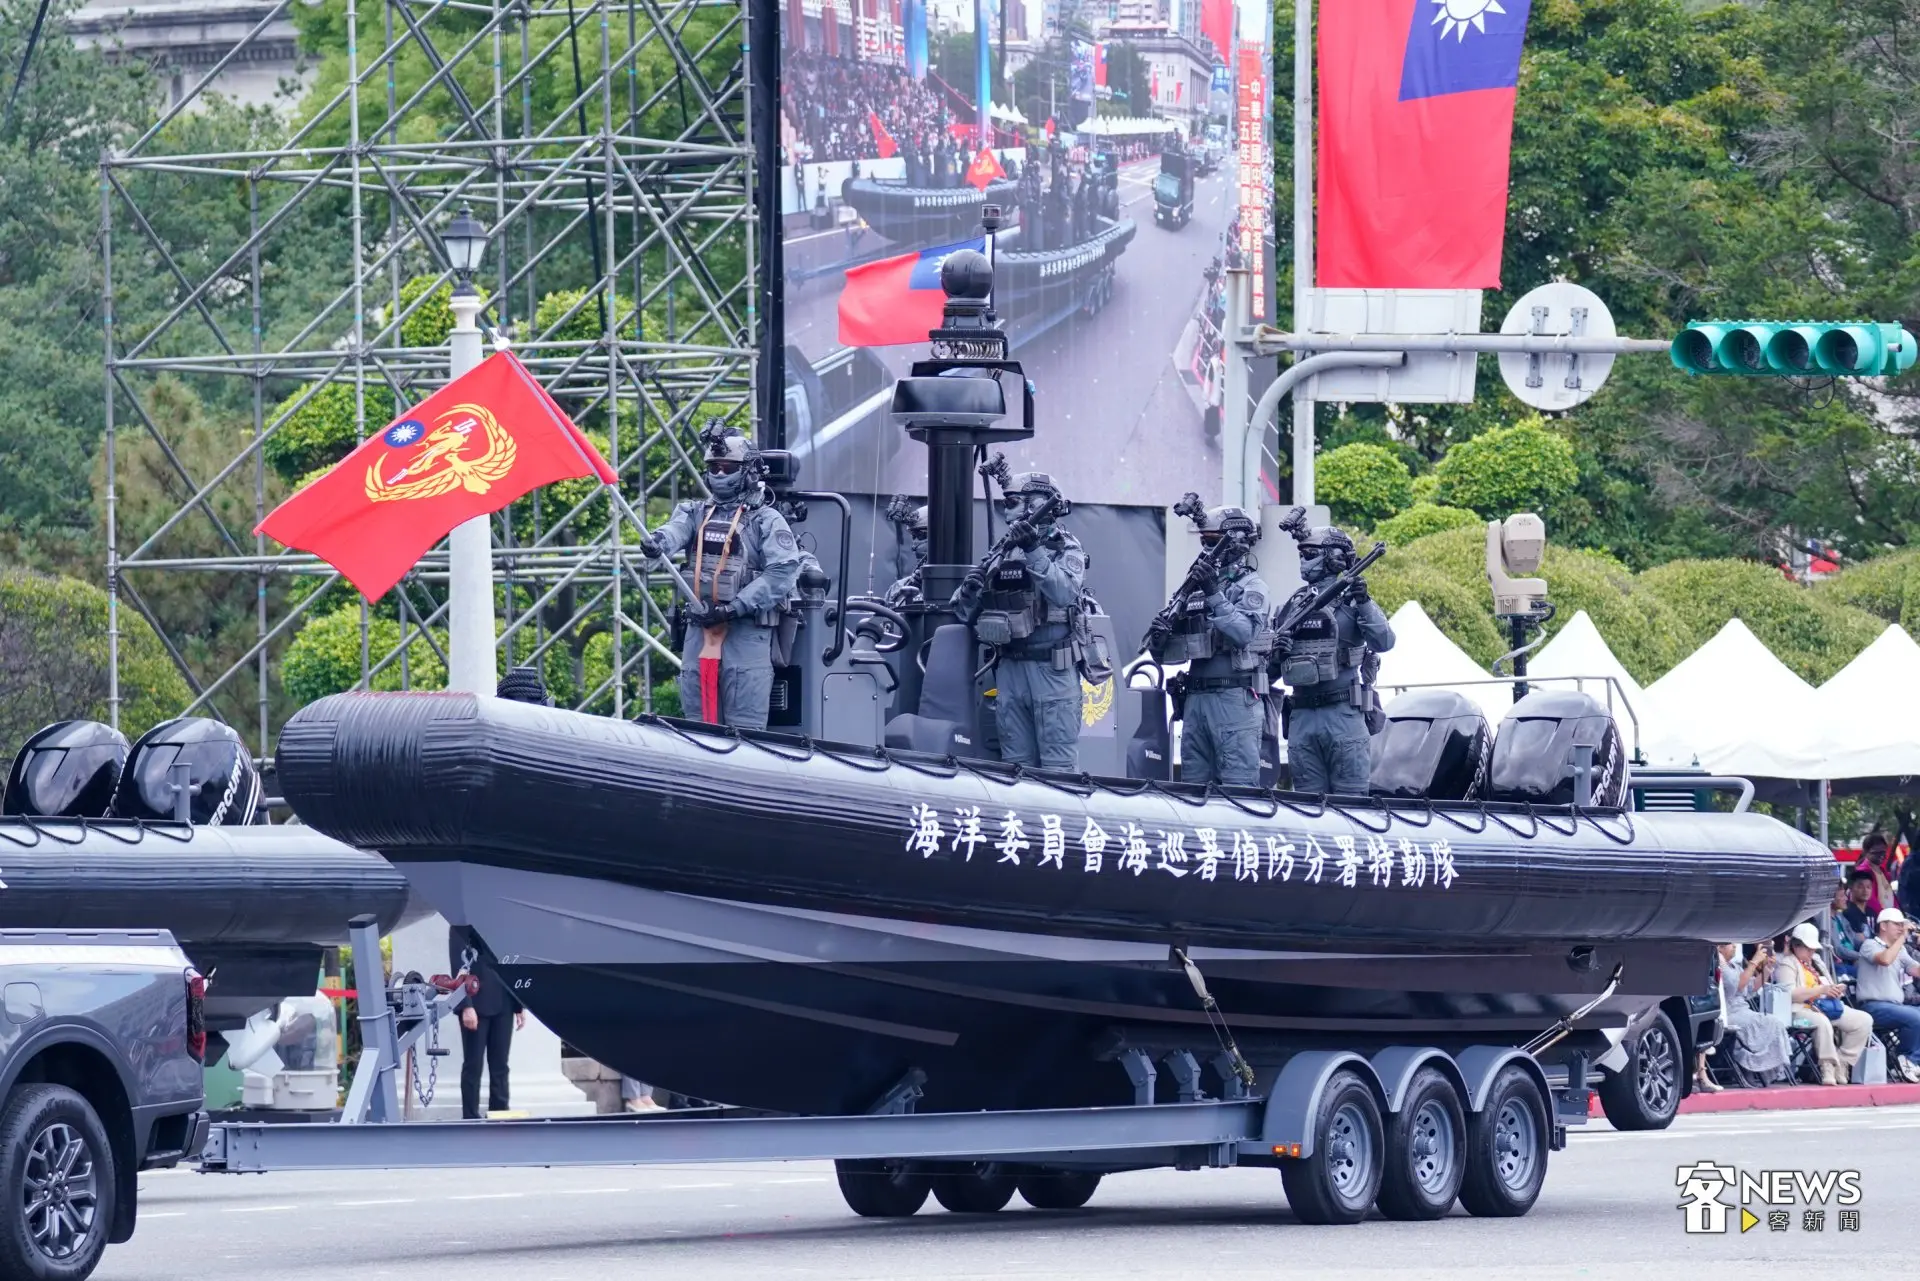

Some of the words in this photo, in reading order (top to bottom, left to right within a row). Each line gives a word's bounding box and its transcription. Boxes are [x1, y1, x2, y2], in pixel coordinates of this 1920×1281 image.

[207, 751, 243, 827] ERCURY
[1590, 728, 1618, 807] ERCURY
[905, 802, 1460, 889] 海洋委員會海巡署偵防分署特勤隊
[502, 955, 520, 964] 0.7
[514, 978, 532, 989] 0.6
